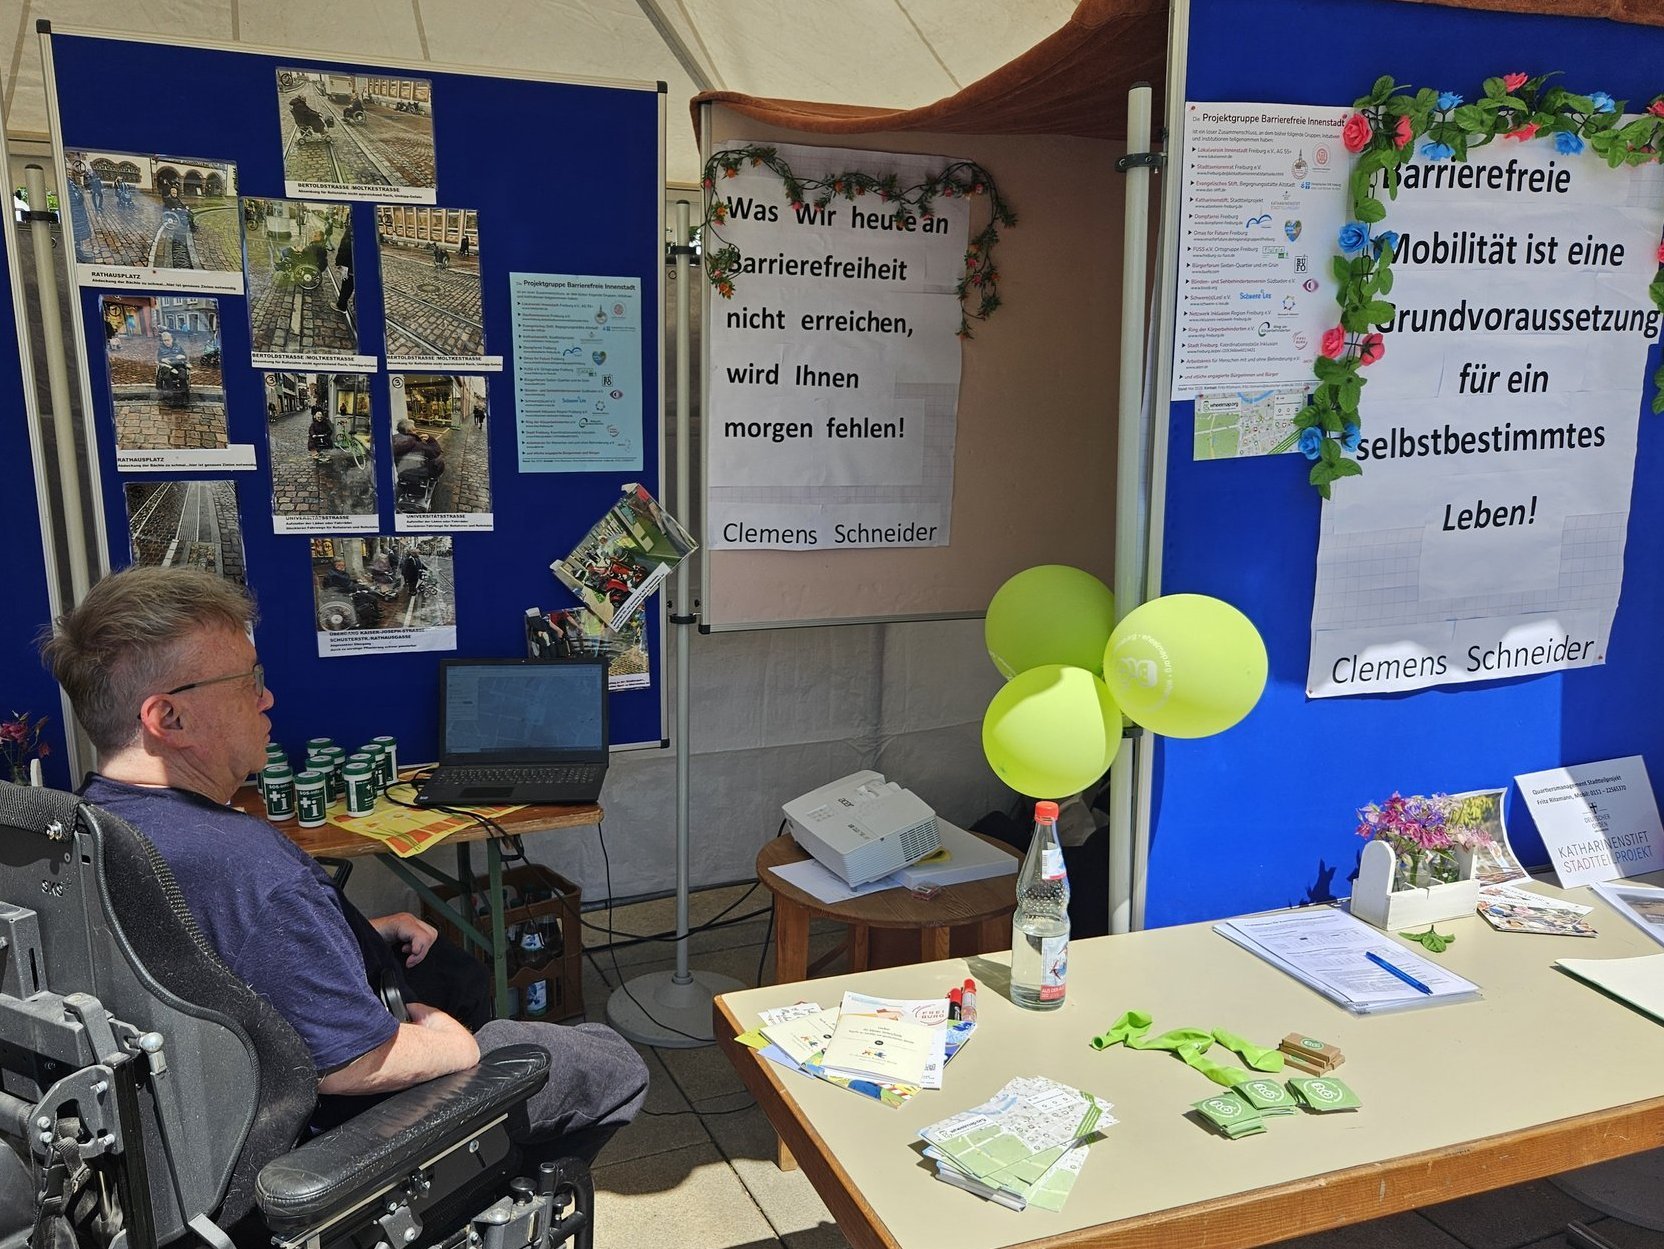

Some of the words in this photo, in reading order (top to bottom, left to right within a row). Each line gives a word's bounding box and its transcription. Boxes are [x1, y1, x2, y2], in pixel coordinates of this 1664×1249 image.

[1202, 114, 1260, 124] Projektgruppe
[1261, 114, 1306, 125] Barrierefreie
[1308, 118, 1345, 128] Innenstadt
[1383, 158, 1571, 194] Barrierefreie
[726, 196, 778, 223] Was
[795, 206, 837, 227] Wir
[851, 206, 917, 232] heute
[922, 216, 949, 234] an
[1391, 230, 1516, 265] Mobilität
[1526, 233, 1558, 265] ist
[1568, 234, 1625, 266] eine
[91, 271, 141, 280] RATHAUSPLATZ
[727, 252, 908, 282] Barrierefreiheit
[523, 280, 566, 288] Projektgruppe
[726, 307, 786, 330] nicht
[801, 311, 914, 338] erreichen,
[726, 364, 780, 386] wird
[795, 365, 860, 388] Ihnen
[1458, 362, 1501, 394] für
[1508, 362, 1549, 394] ein
[724, 420, 813, 443] morgen
[826, 417, 905, 438] fehlen!
[1356, 422, 1605, 461] selbstbestimmtes
[1442, 496, 1538, 532] Leben!
[722, 522, 818, 544] Clemens
[834, 522, 938, 544] Schneider
[1332, 654, 1447, 684] Clemens
[1466, 634, 1595, 672] Schneider
[1532, 780, 1586, 795] Quartiersmanagement
[1558, 831, 1648, 858] KATHARINENSTIFT
[1564, 846, 1653, 874] STADTTEILPROJEKT
